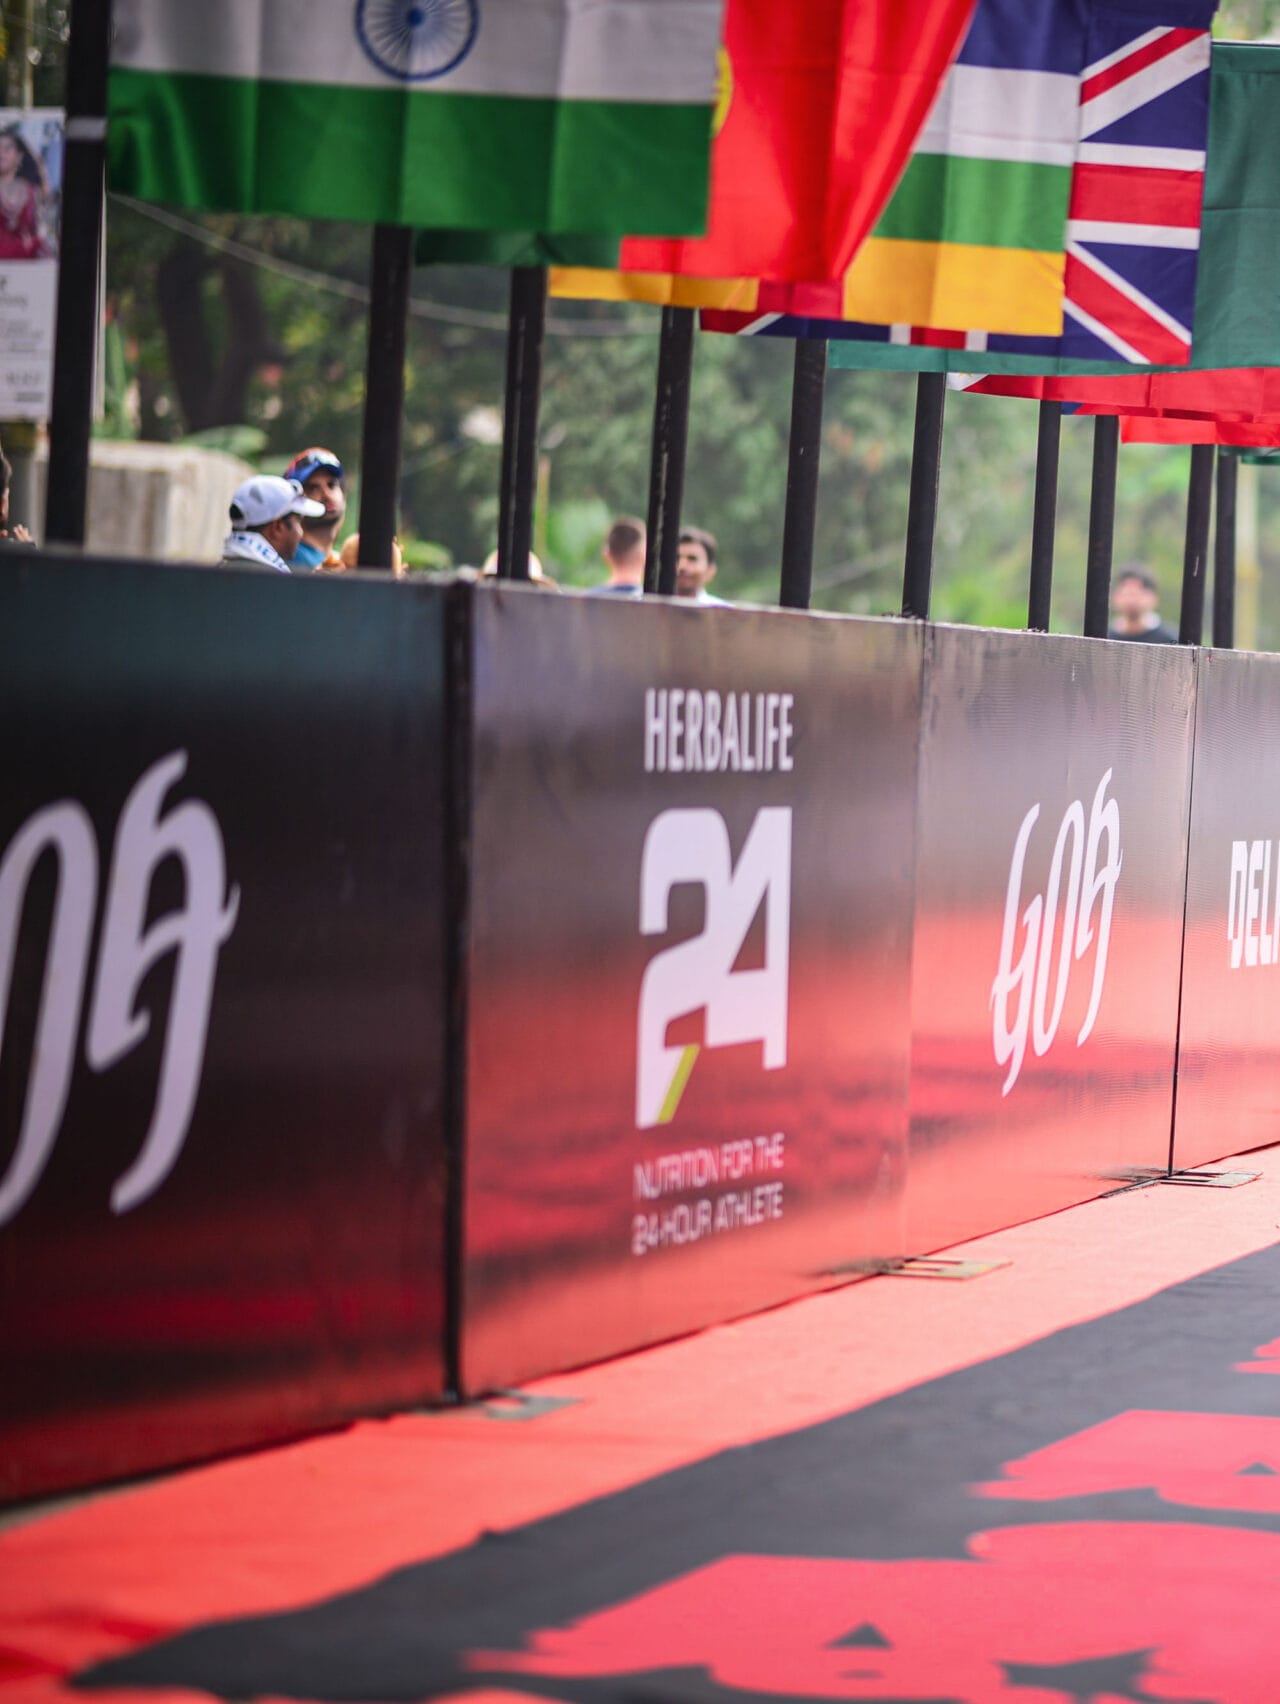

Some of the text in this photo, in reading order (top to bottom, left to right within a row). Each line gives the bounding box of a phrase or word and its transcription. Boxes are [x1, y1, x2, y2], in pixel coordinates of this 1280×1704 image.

[644, 688, 795, 772] HERBALIFE
[635, 805, 793, 1130] 24
[633, 1131, 785, 1200] NUTRITION FOR THE
[713, 1182, 784, 1231] ATHLETE
